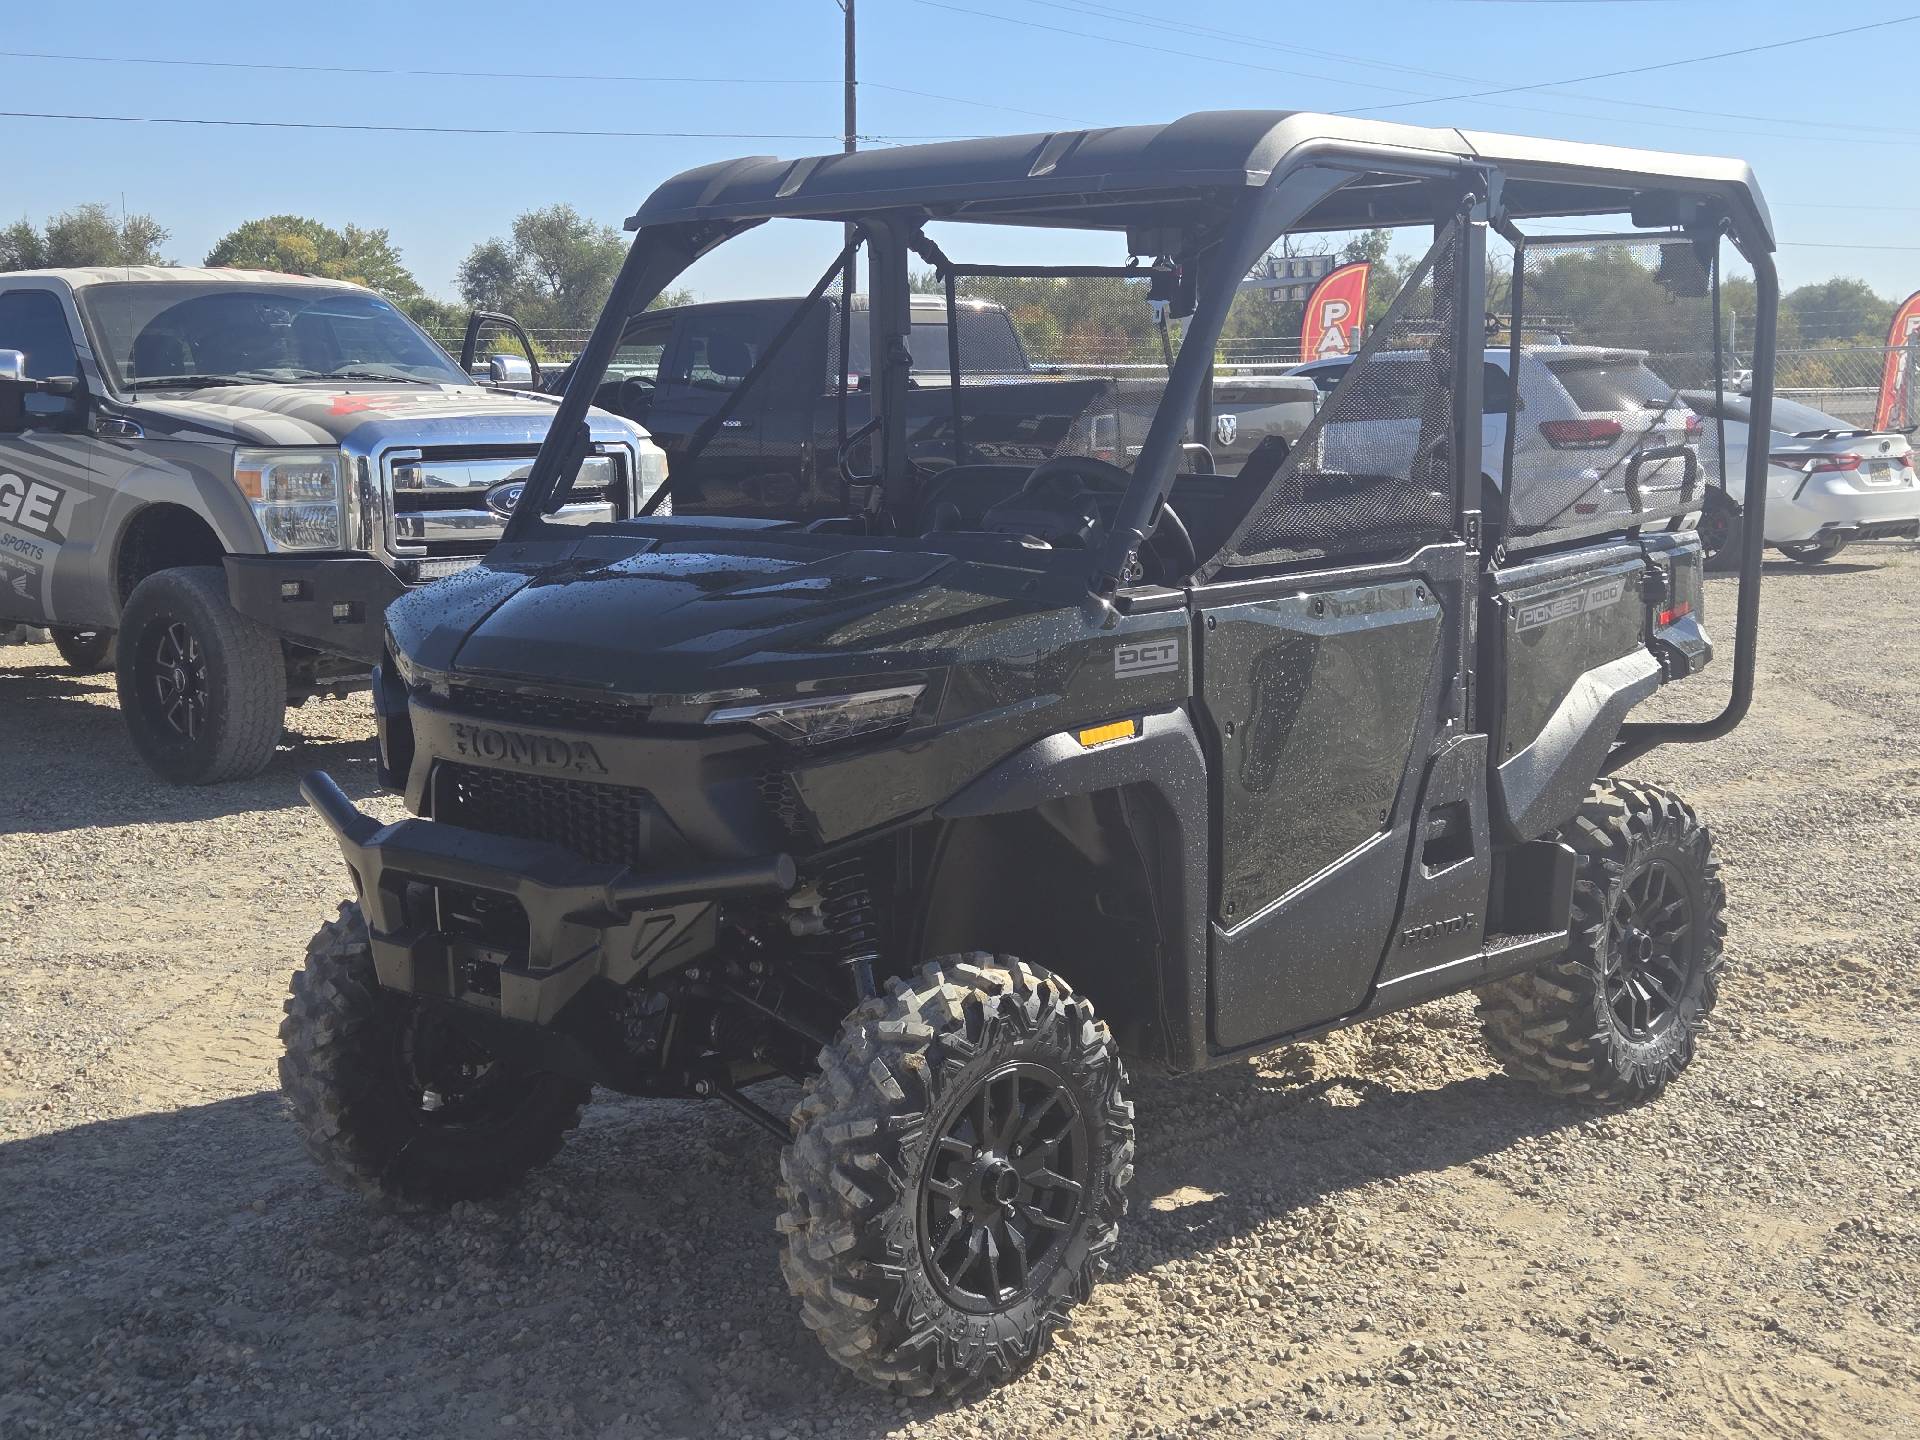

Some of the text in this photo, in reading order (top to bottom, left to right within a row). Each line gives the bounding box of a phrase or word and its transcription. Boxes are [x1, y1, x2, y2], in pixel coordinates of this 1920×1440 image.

[1318, 303, 1348, 359] PA
[0, 473, 59, 532] GE
[1, 533, 44, 560] SPORTS
[1523, 587, 1617, 625] PIONEER 1000
[1119, 644, 1174, 665] DCT
[450, 722, 608, 775] HONDA
[1402, 912, 1476, 947] HONDA
